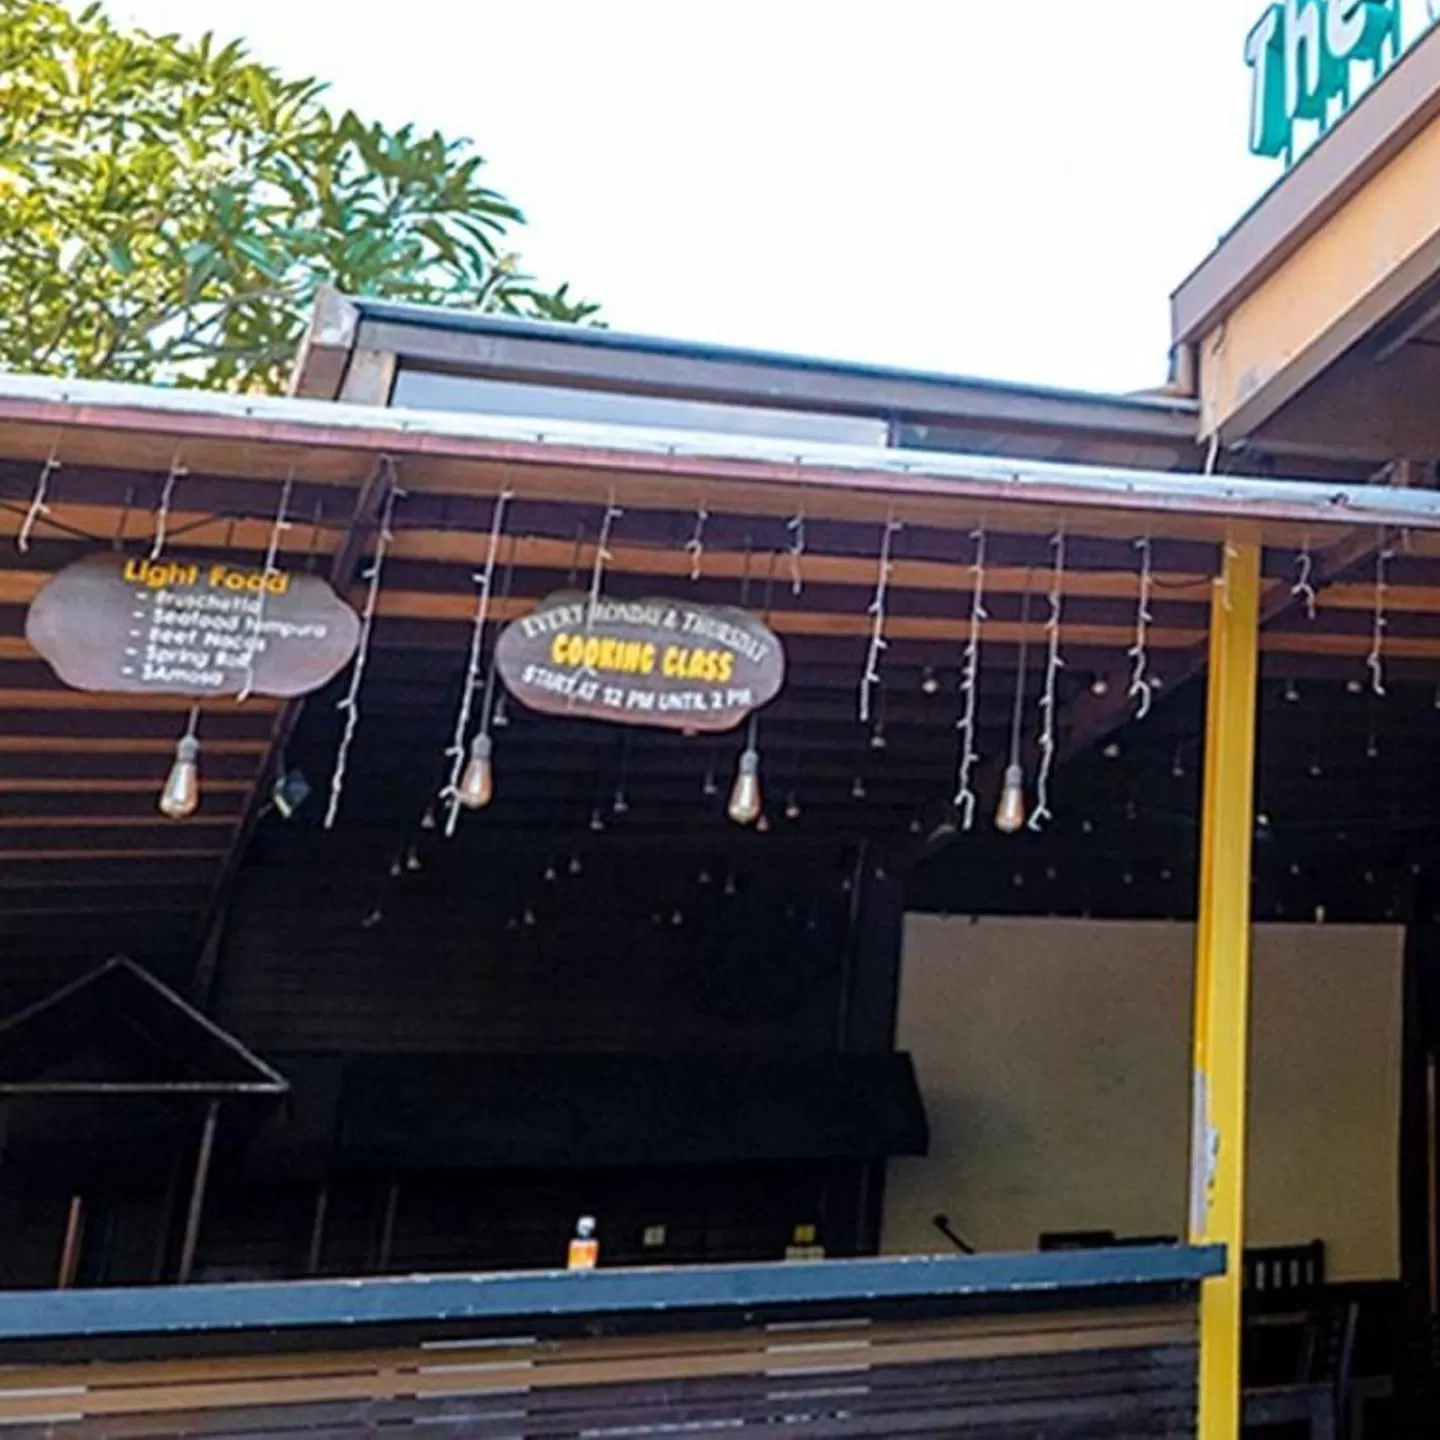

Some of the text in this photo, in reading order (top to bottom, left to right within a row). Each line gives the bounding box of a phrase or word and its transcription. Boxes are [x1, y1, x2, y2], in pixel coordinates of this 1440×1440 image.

[123, 560, 289, 594] Light Food
[149, 626, 197, 645] Beef
[521, 603, 583, 638] EVERY
[682, 610, 770, 663] THURSDAY
[146, 644, 210, 669] Spring
[552, 632, 735, 683] COOKING CLASS
[626, 689, 654, 710] PM
[726, 688, 751, 707] PM
